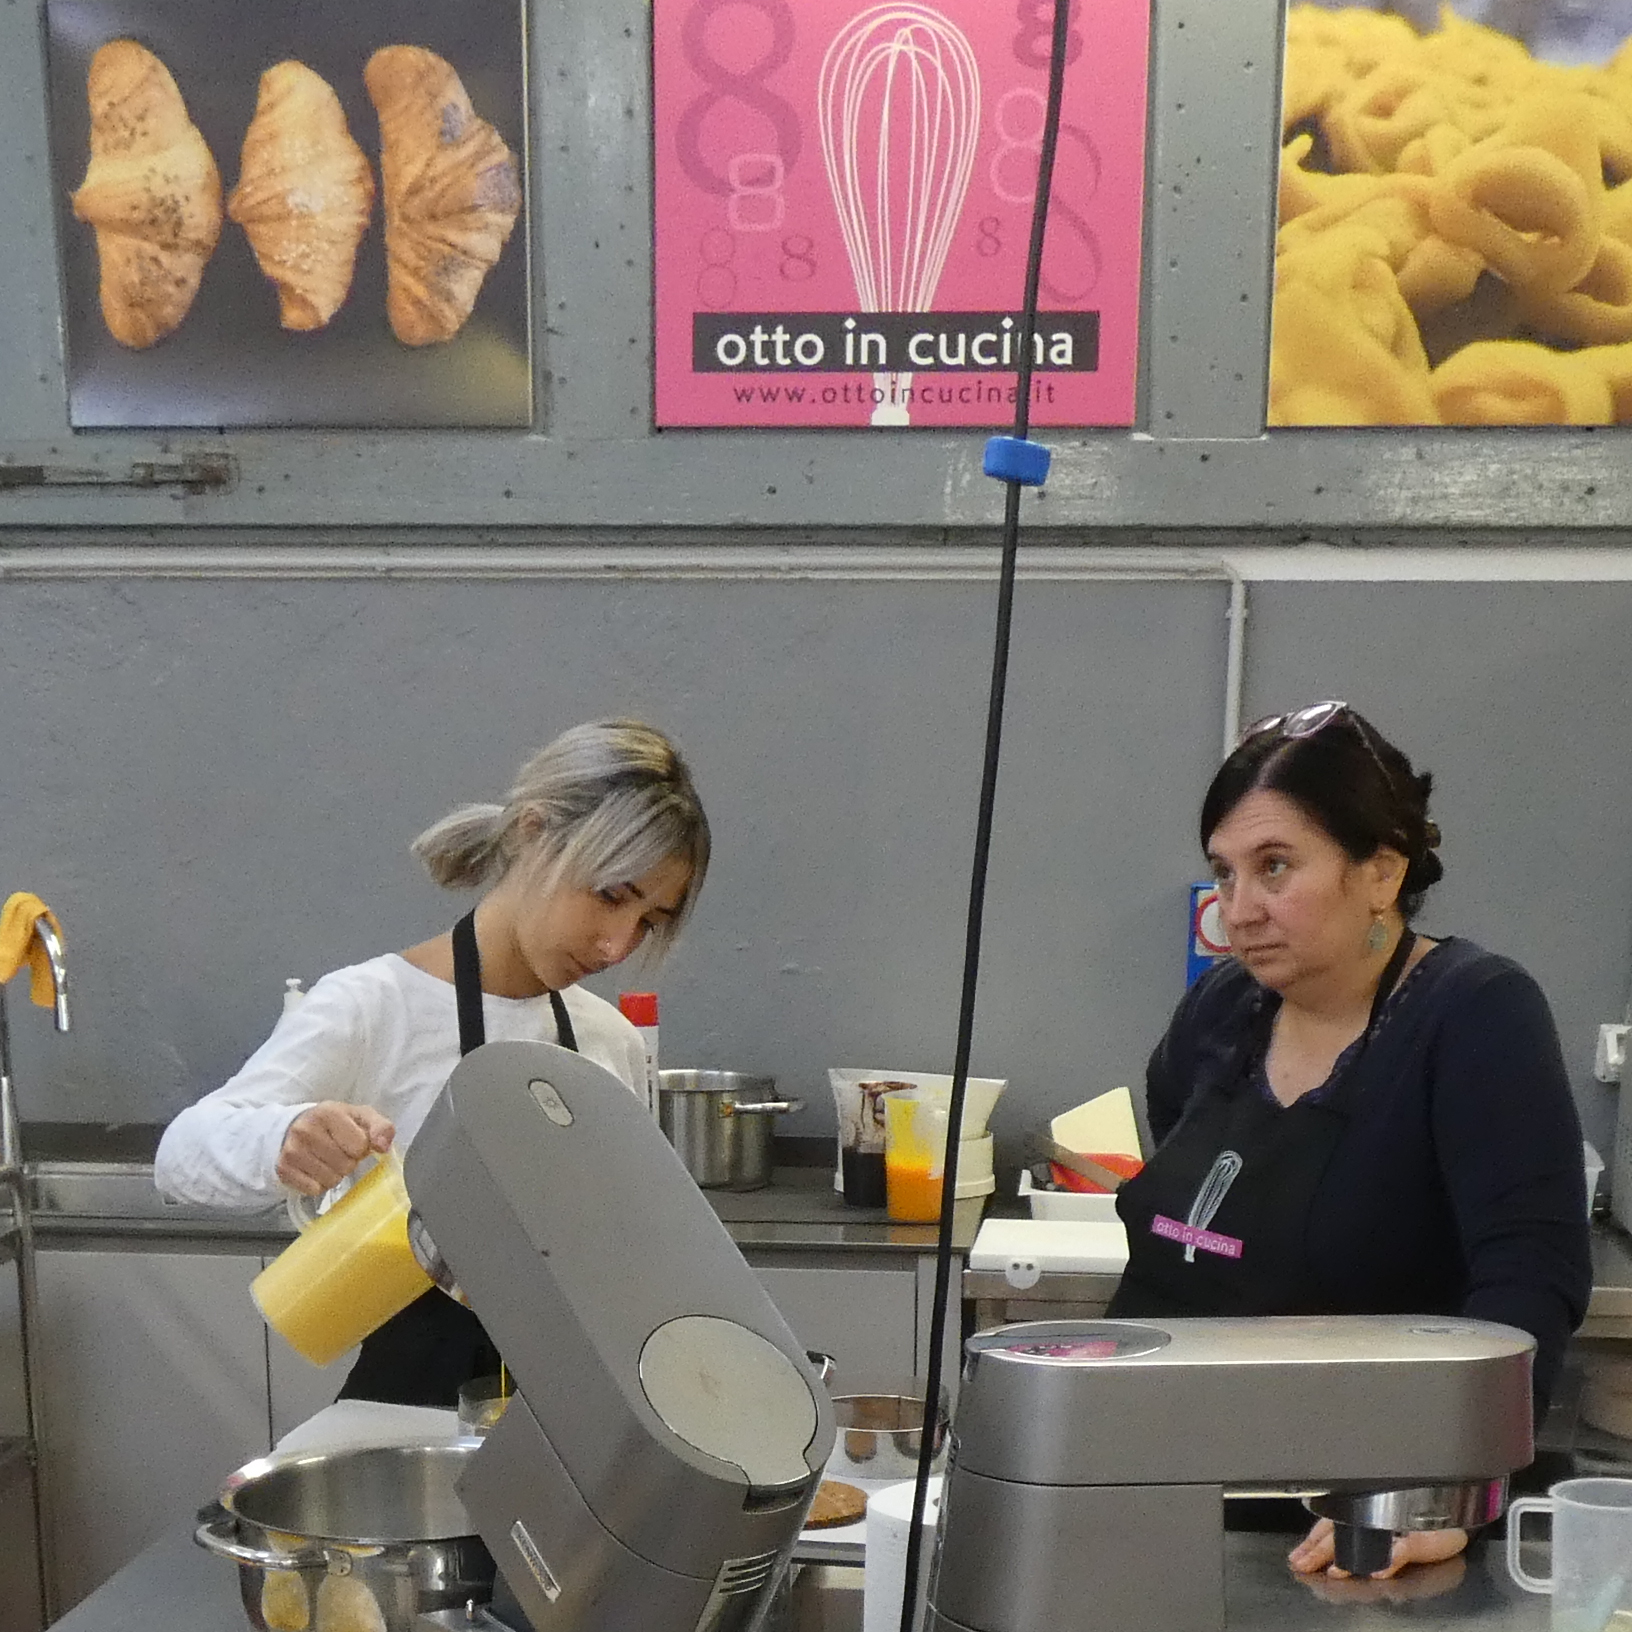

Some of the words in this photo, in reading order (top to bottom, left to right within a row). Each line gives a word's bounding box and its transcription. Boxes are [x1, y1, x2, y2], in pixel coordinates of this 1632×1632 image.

[716, 325, 825, 366] otto
[844, 317, 887, 365] in
[908, 316, 1074, 366] cucina
[733, 380, 1056, 405] www.ottoincucinait
[1156, 1222, 1180, 1238] otto
[1182, 1226, 1193, 1243] in
[1196, 1236, 1236, 1255] cucina
